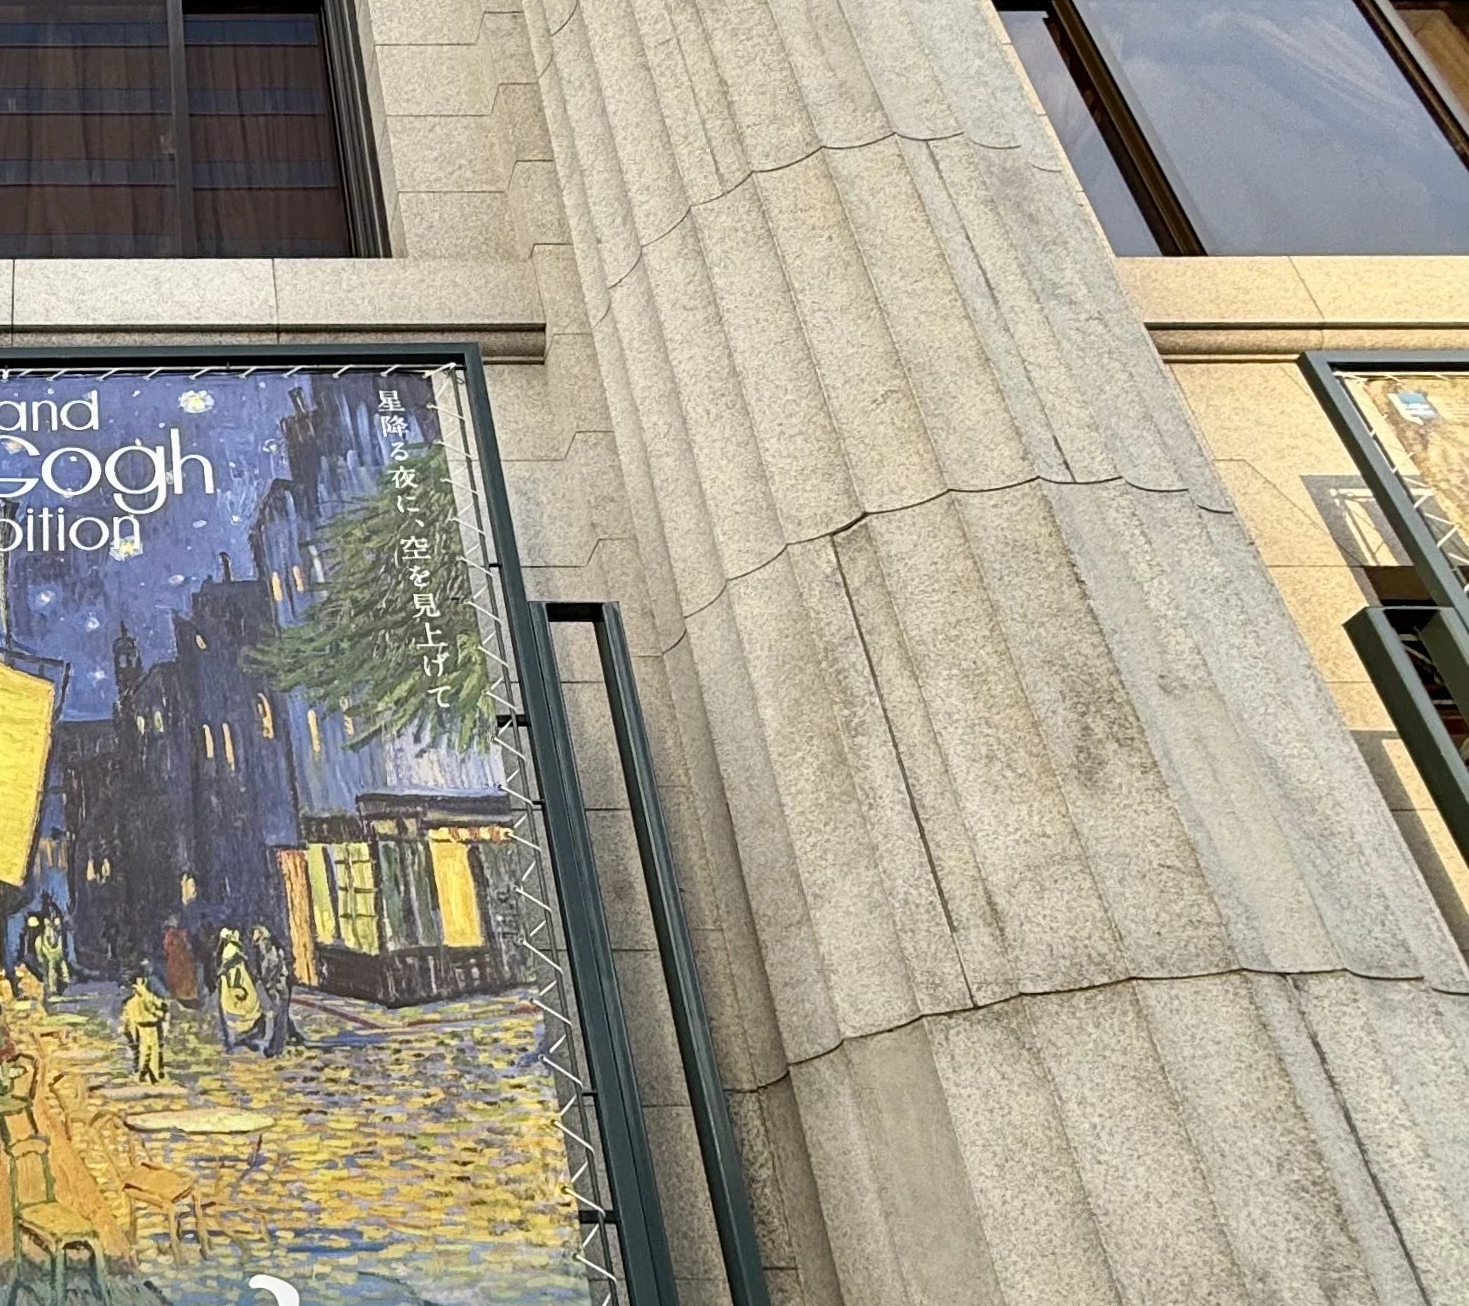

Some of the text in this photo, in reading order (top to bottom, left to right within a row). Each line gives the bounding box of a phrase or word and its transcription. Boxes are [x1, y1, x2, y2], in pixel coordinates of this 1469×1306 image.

[378, 390, 451, 709] 星降る夜に、空を見上げて
